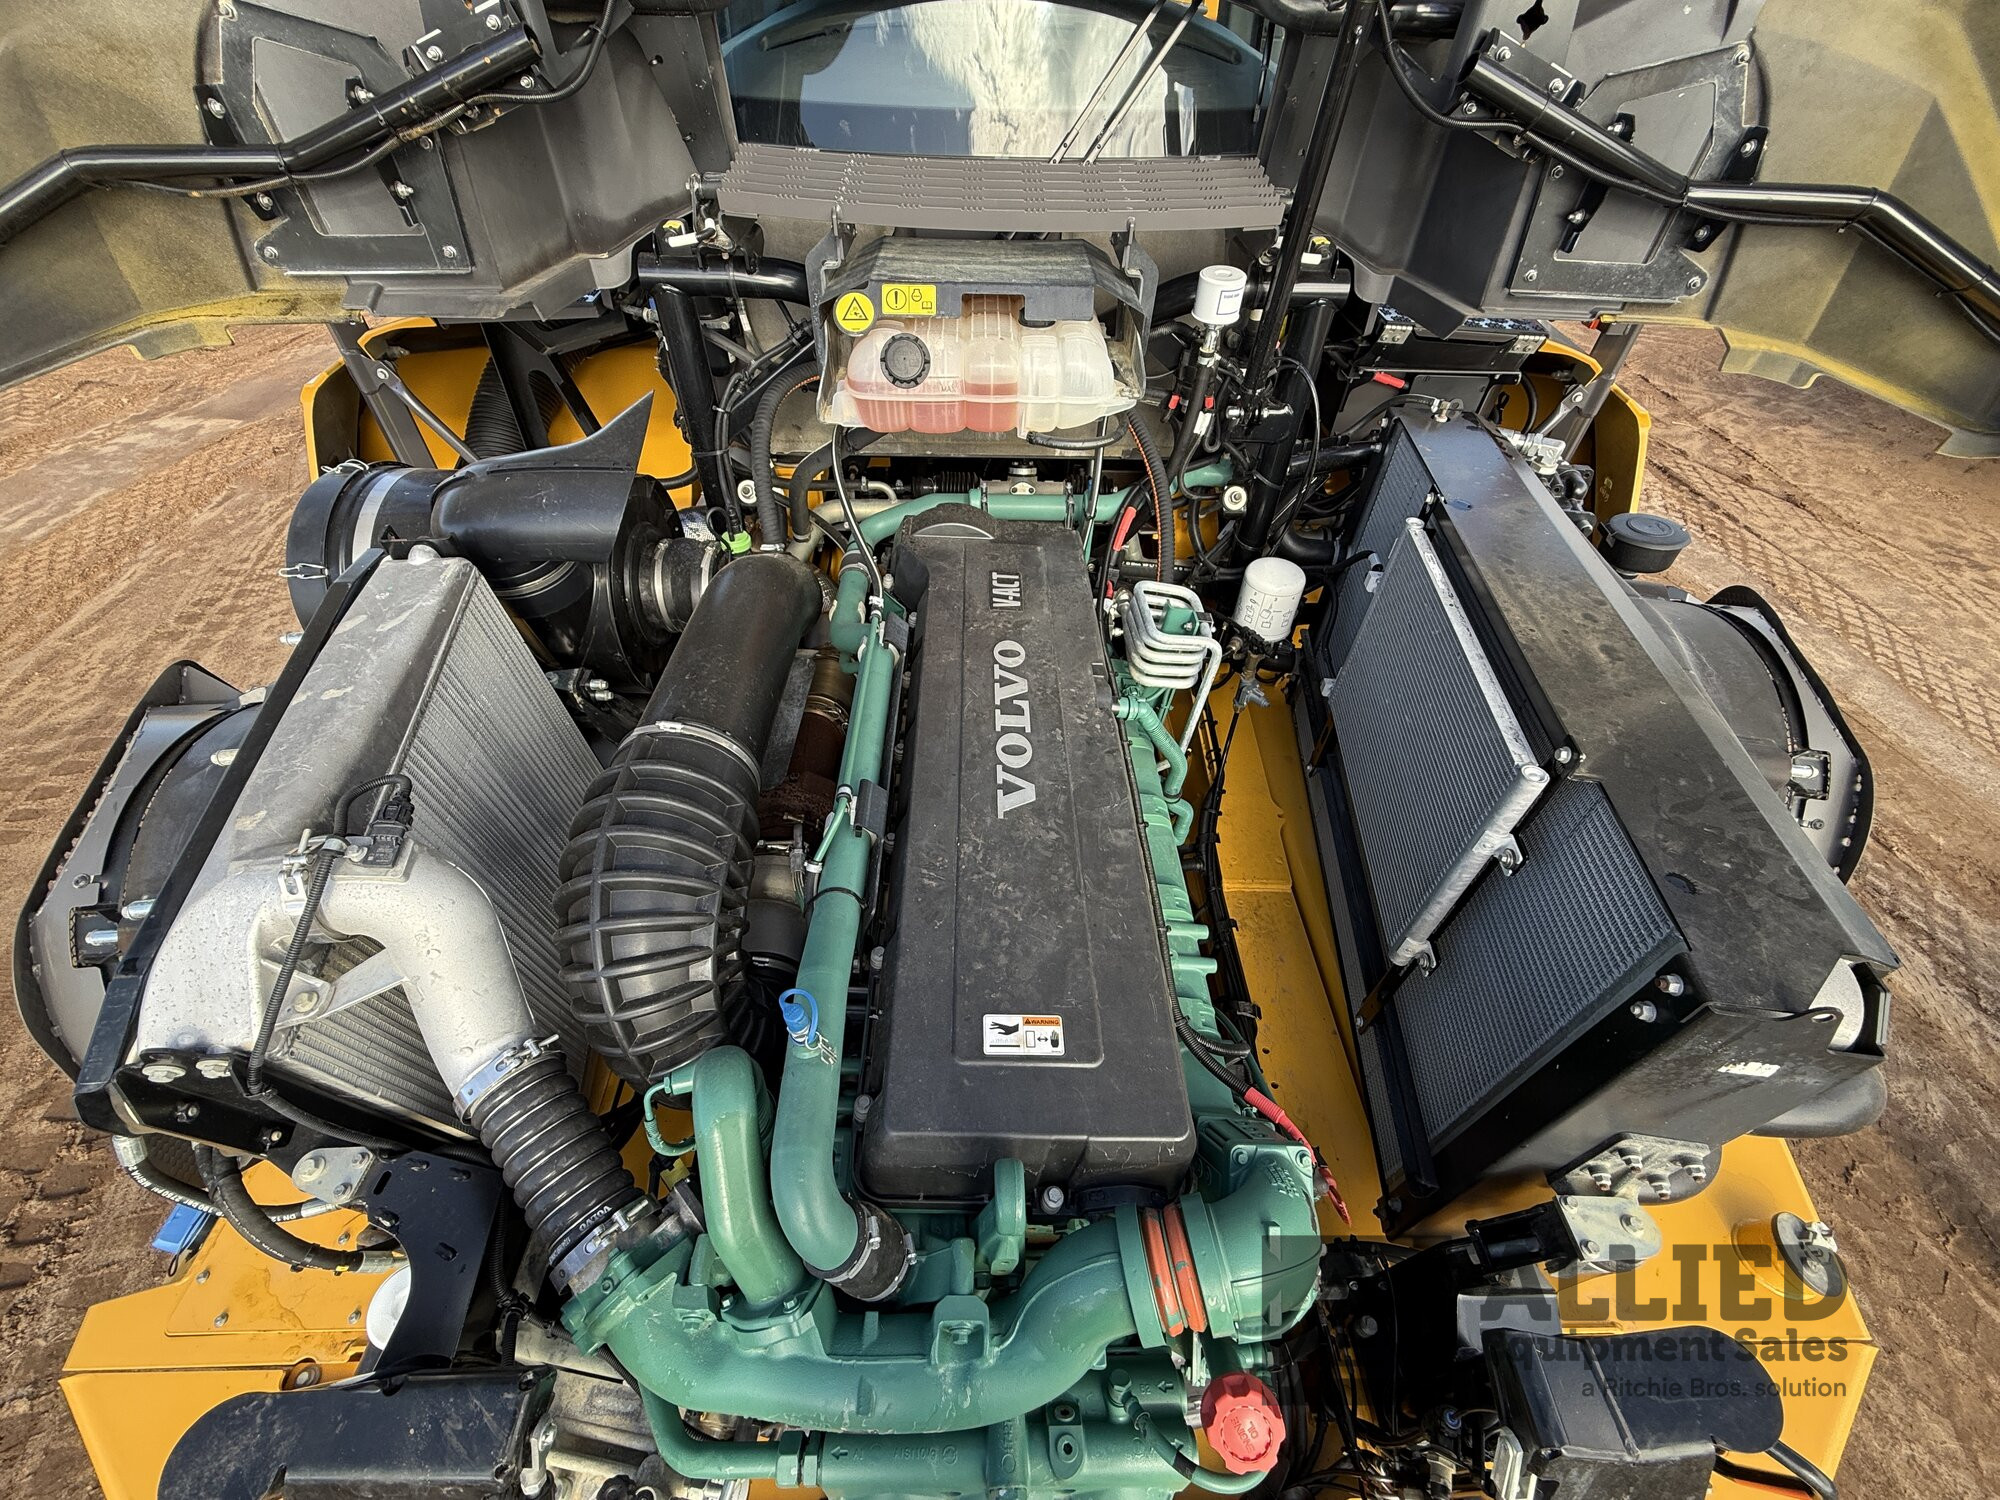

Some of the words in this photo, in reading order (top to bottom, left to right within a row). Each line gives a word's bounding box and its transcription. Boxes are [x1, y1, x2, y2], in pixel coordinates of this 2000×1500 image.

[992, 572, 1021, 607] V-ACT
[993, 640, 1036, 819] VOLVO
[130, 1170, 152, 1188] MSHA
[282, 1213, 297, 1221] DN
[579, 1205, 612, 1232] VOLVO
[1231, 1416, 1255, 1454] ENGINE
[1247, 1420, 1259, 1439] OIL
